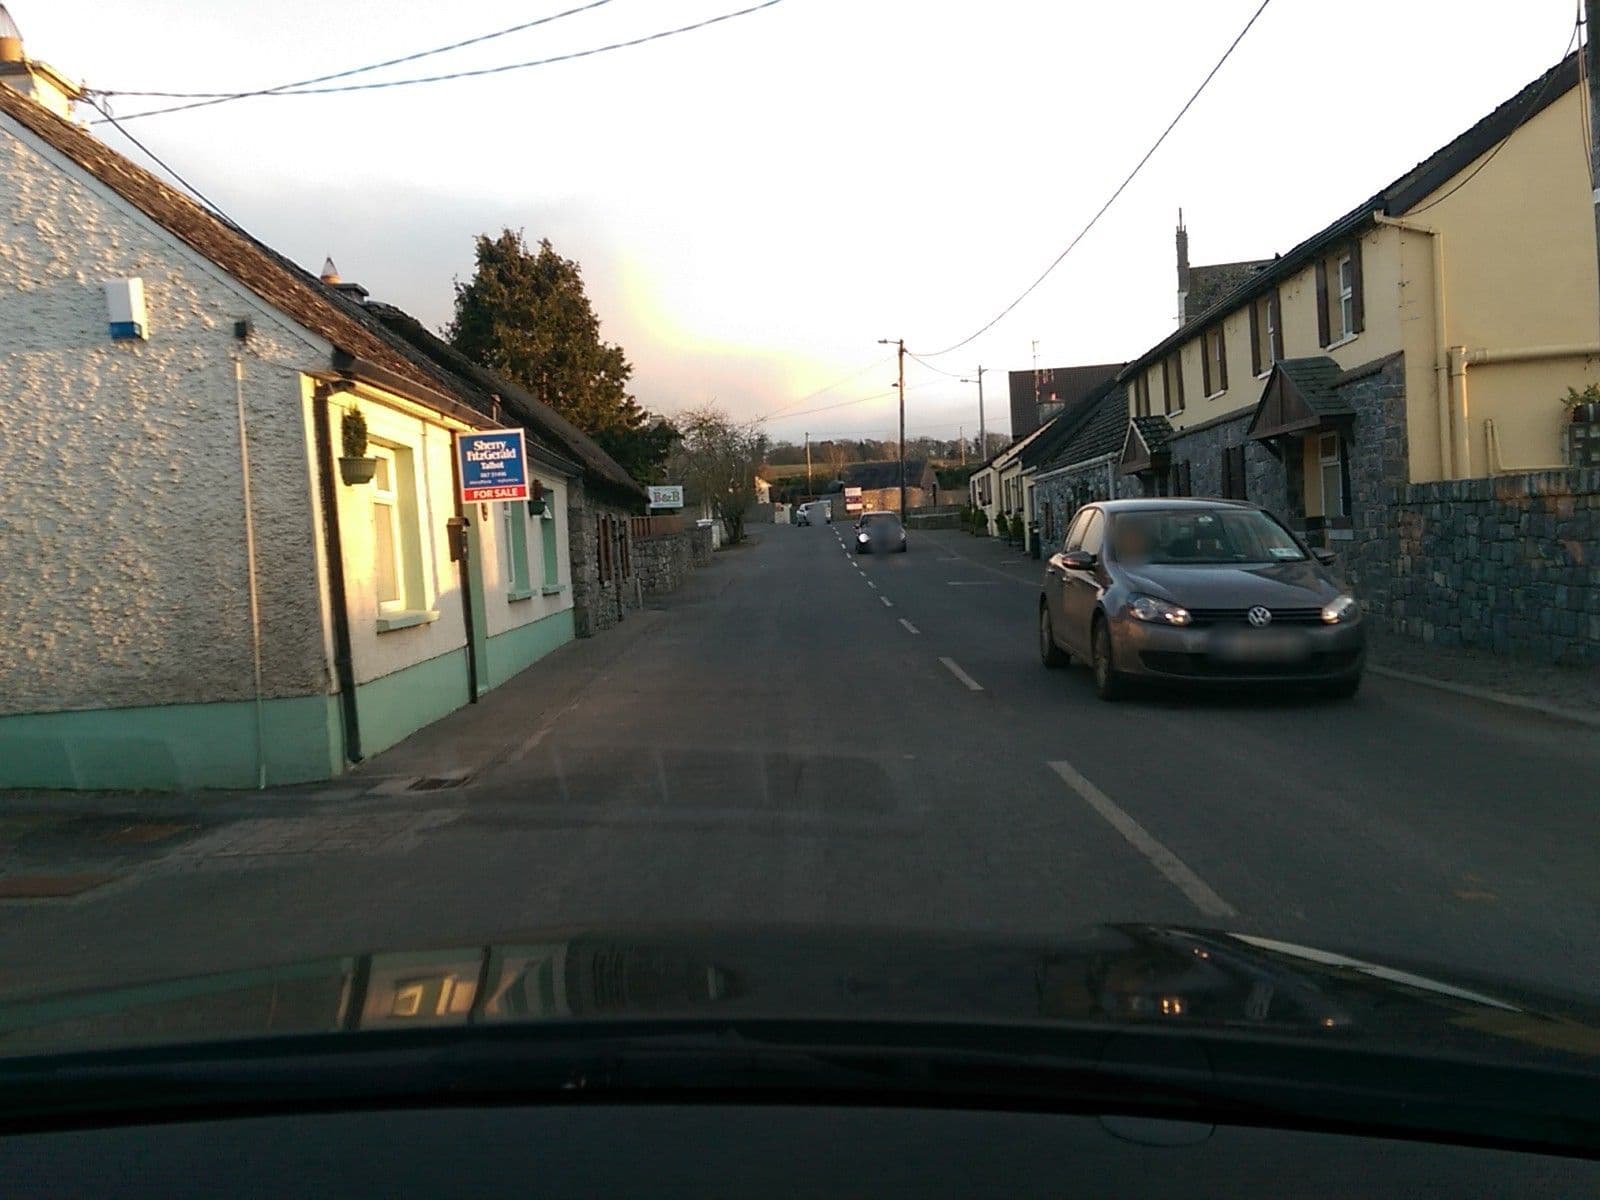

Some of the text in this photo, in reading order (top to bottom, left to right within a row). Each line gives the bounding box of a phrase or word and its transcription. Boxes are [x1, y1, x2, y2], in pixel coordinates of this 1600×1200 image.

[474, 440, 506, 451] Sherry
[467, 448, 516, 461] FitzGerald
[473, 487, 518, 498] FOR SALE
[654, 491, 680, 502] B&B
